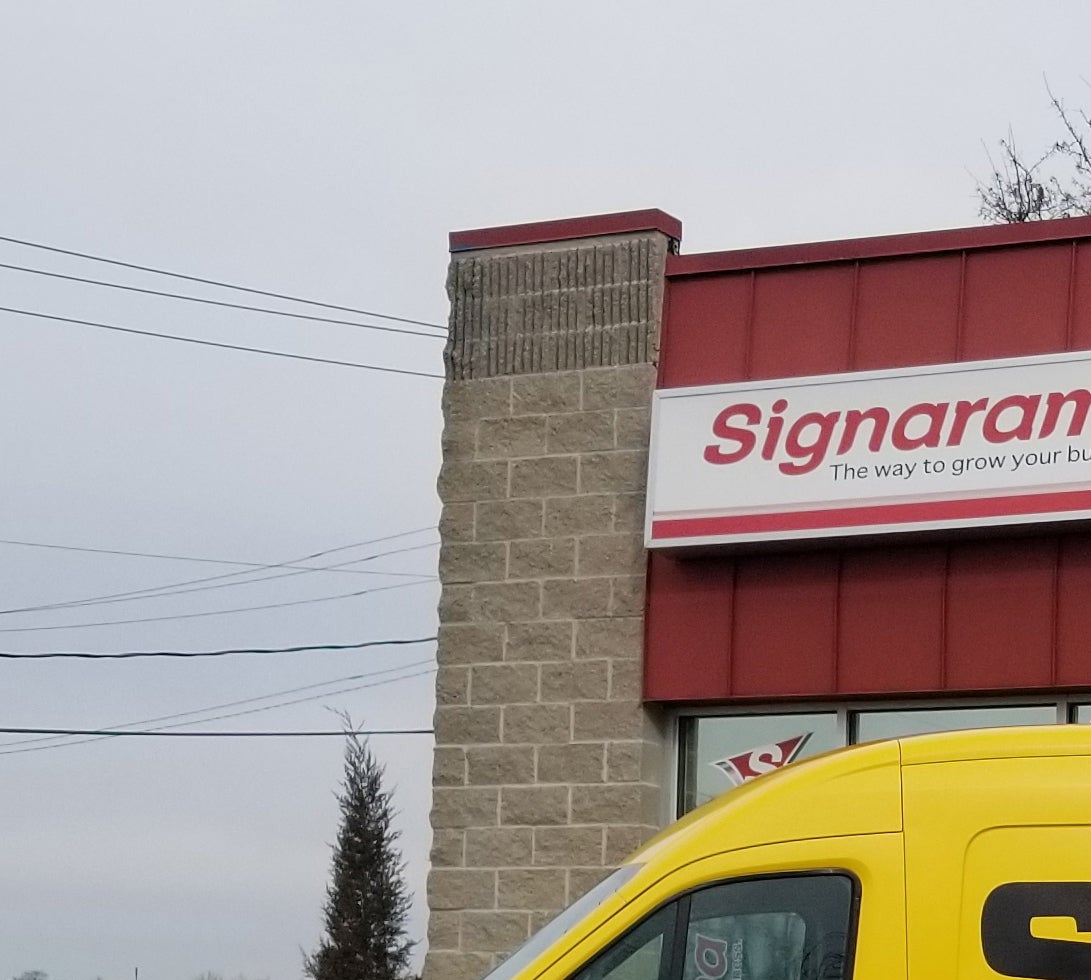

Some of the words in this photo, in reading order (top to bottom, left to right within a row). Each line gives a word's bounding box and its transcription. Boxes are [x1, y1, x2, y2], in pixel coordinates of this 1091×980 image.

[830, 463, 868, 482] The
[874, 461, 917, 479] way
[923, 457, 946, 474] to
[951, 456, 1007, 477] grow
[1011, 448, 1063, 472] your
